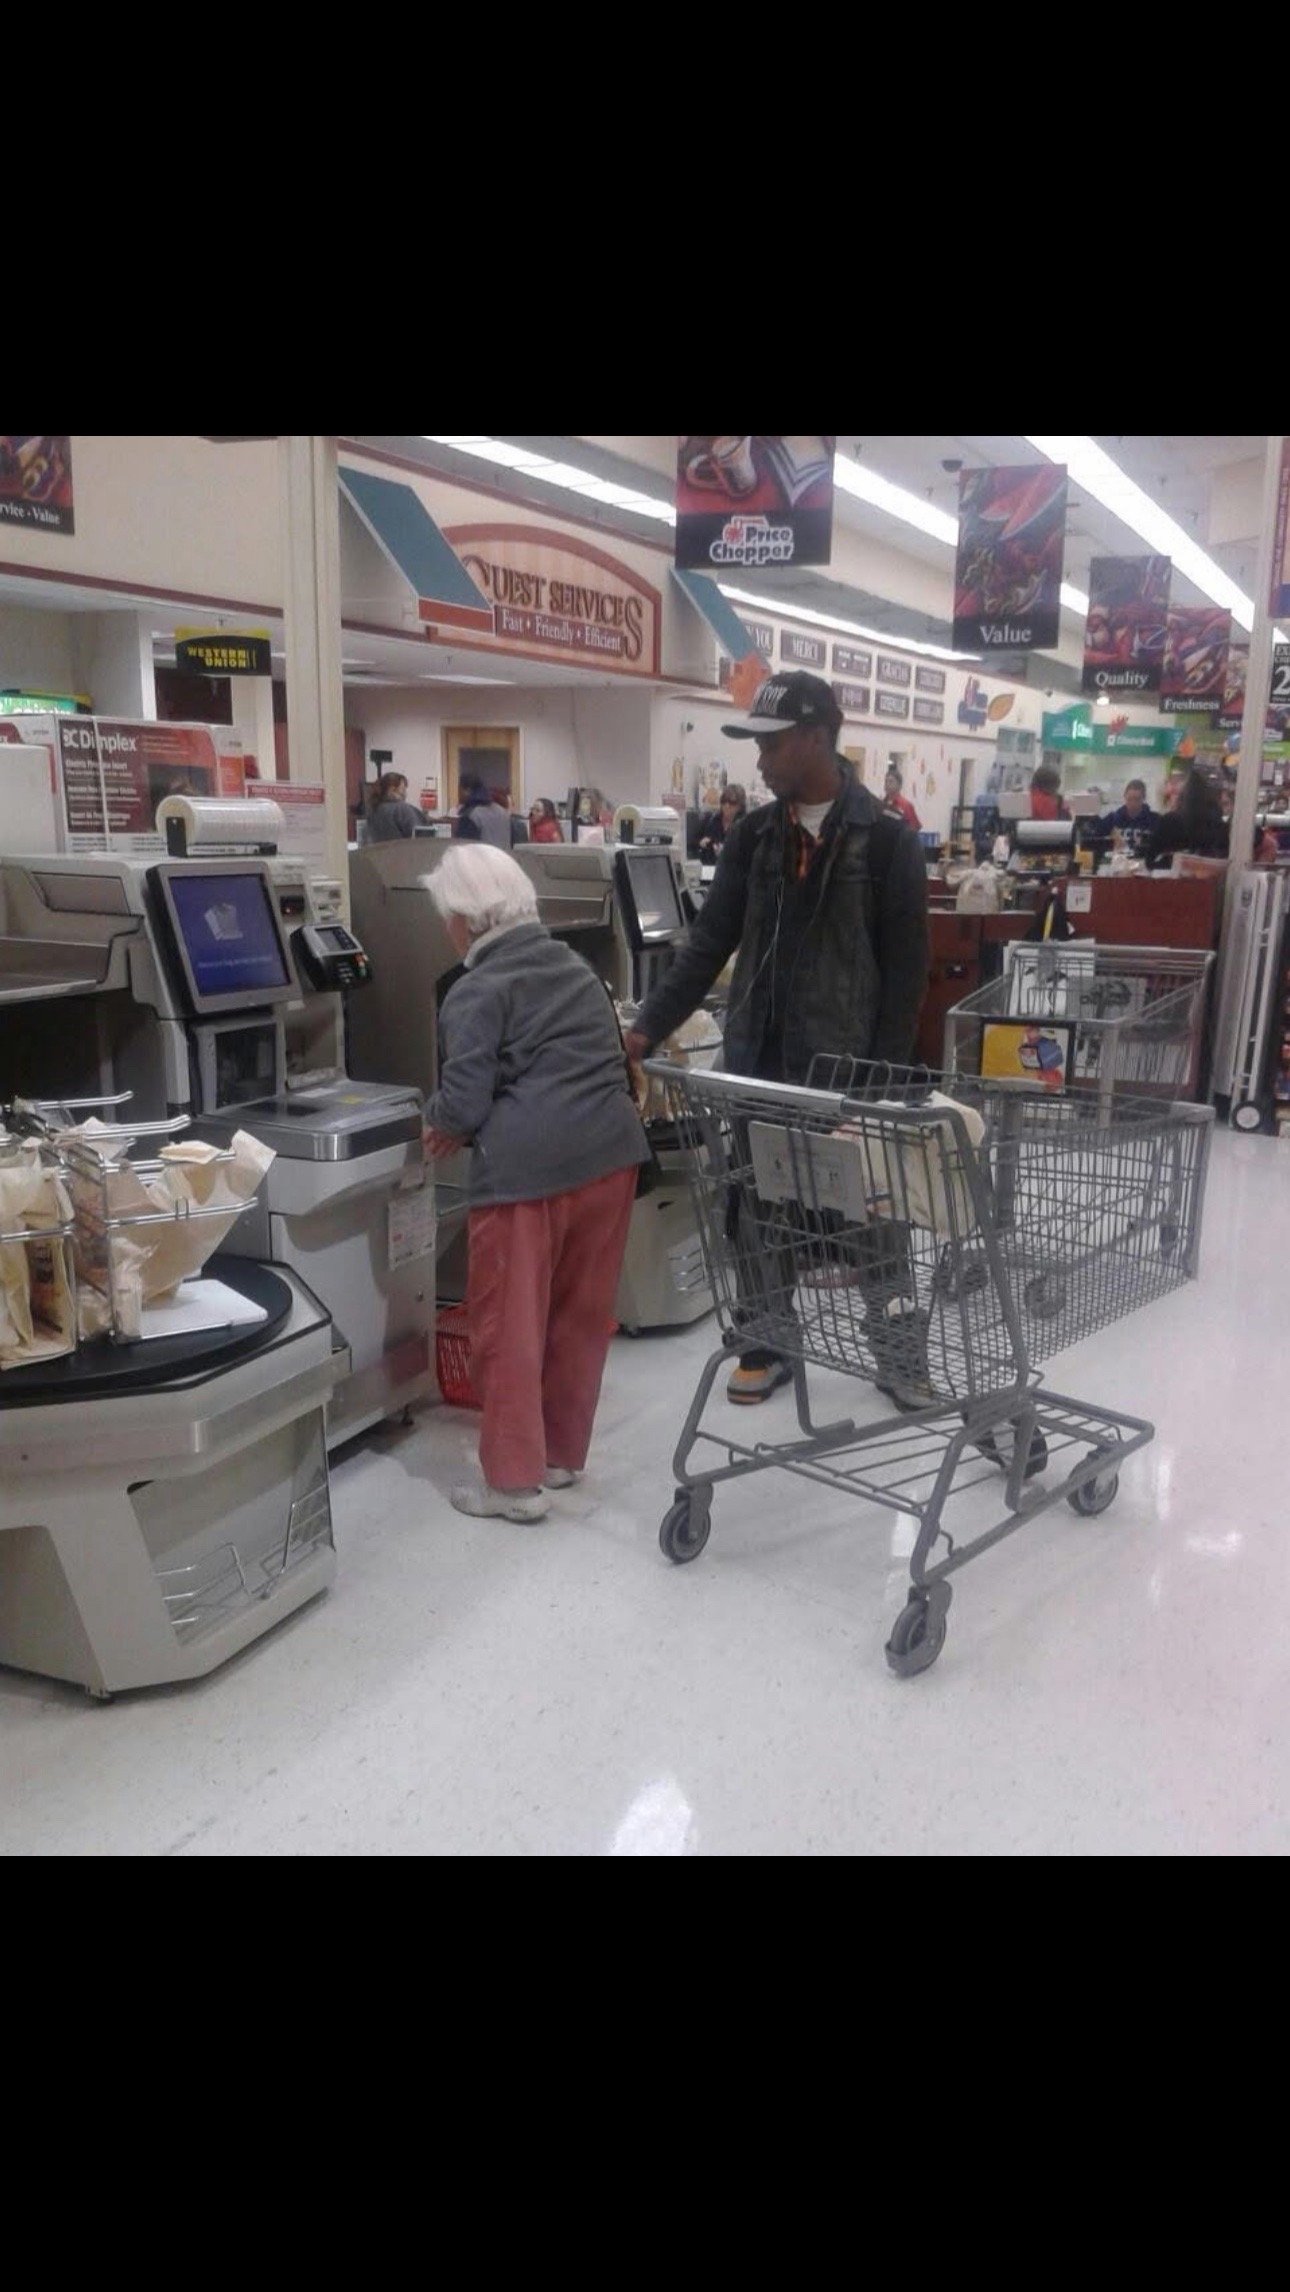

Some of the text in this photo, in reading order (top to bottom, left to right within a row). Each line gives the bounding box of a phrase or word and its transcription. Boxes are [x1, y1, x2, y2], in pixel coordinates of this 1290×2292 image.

[744, 525, 792, 544] Price
[710, 541, 794, 565] Chopper
[502, 608, 622, 651] Fast Friendly Efficient
[549, 579, 643, 661] SERVICES
[980, 623, 1032, 644] Value
[187, 646, 246, 659] WESTERN
[205, 657, 246, 668] UNION
[1096, 671, 1149, 688] Quality
[1164, 697, 1220, 710] Freshness
